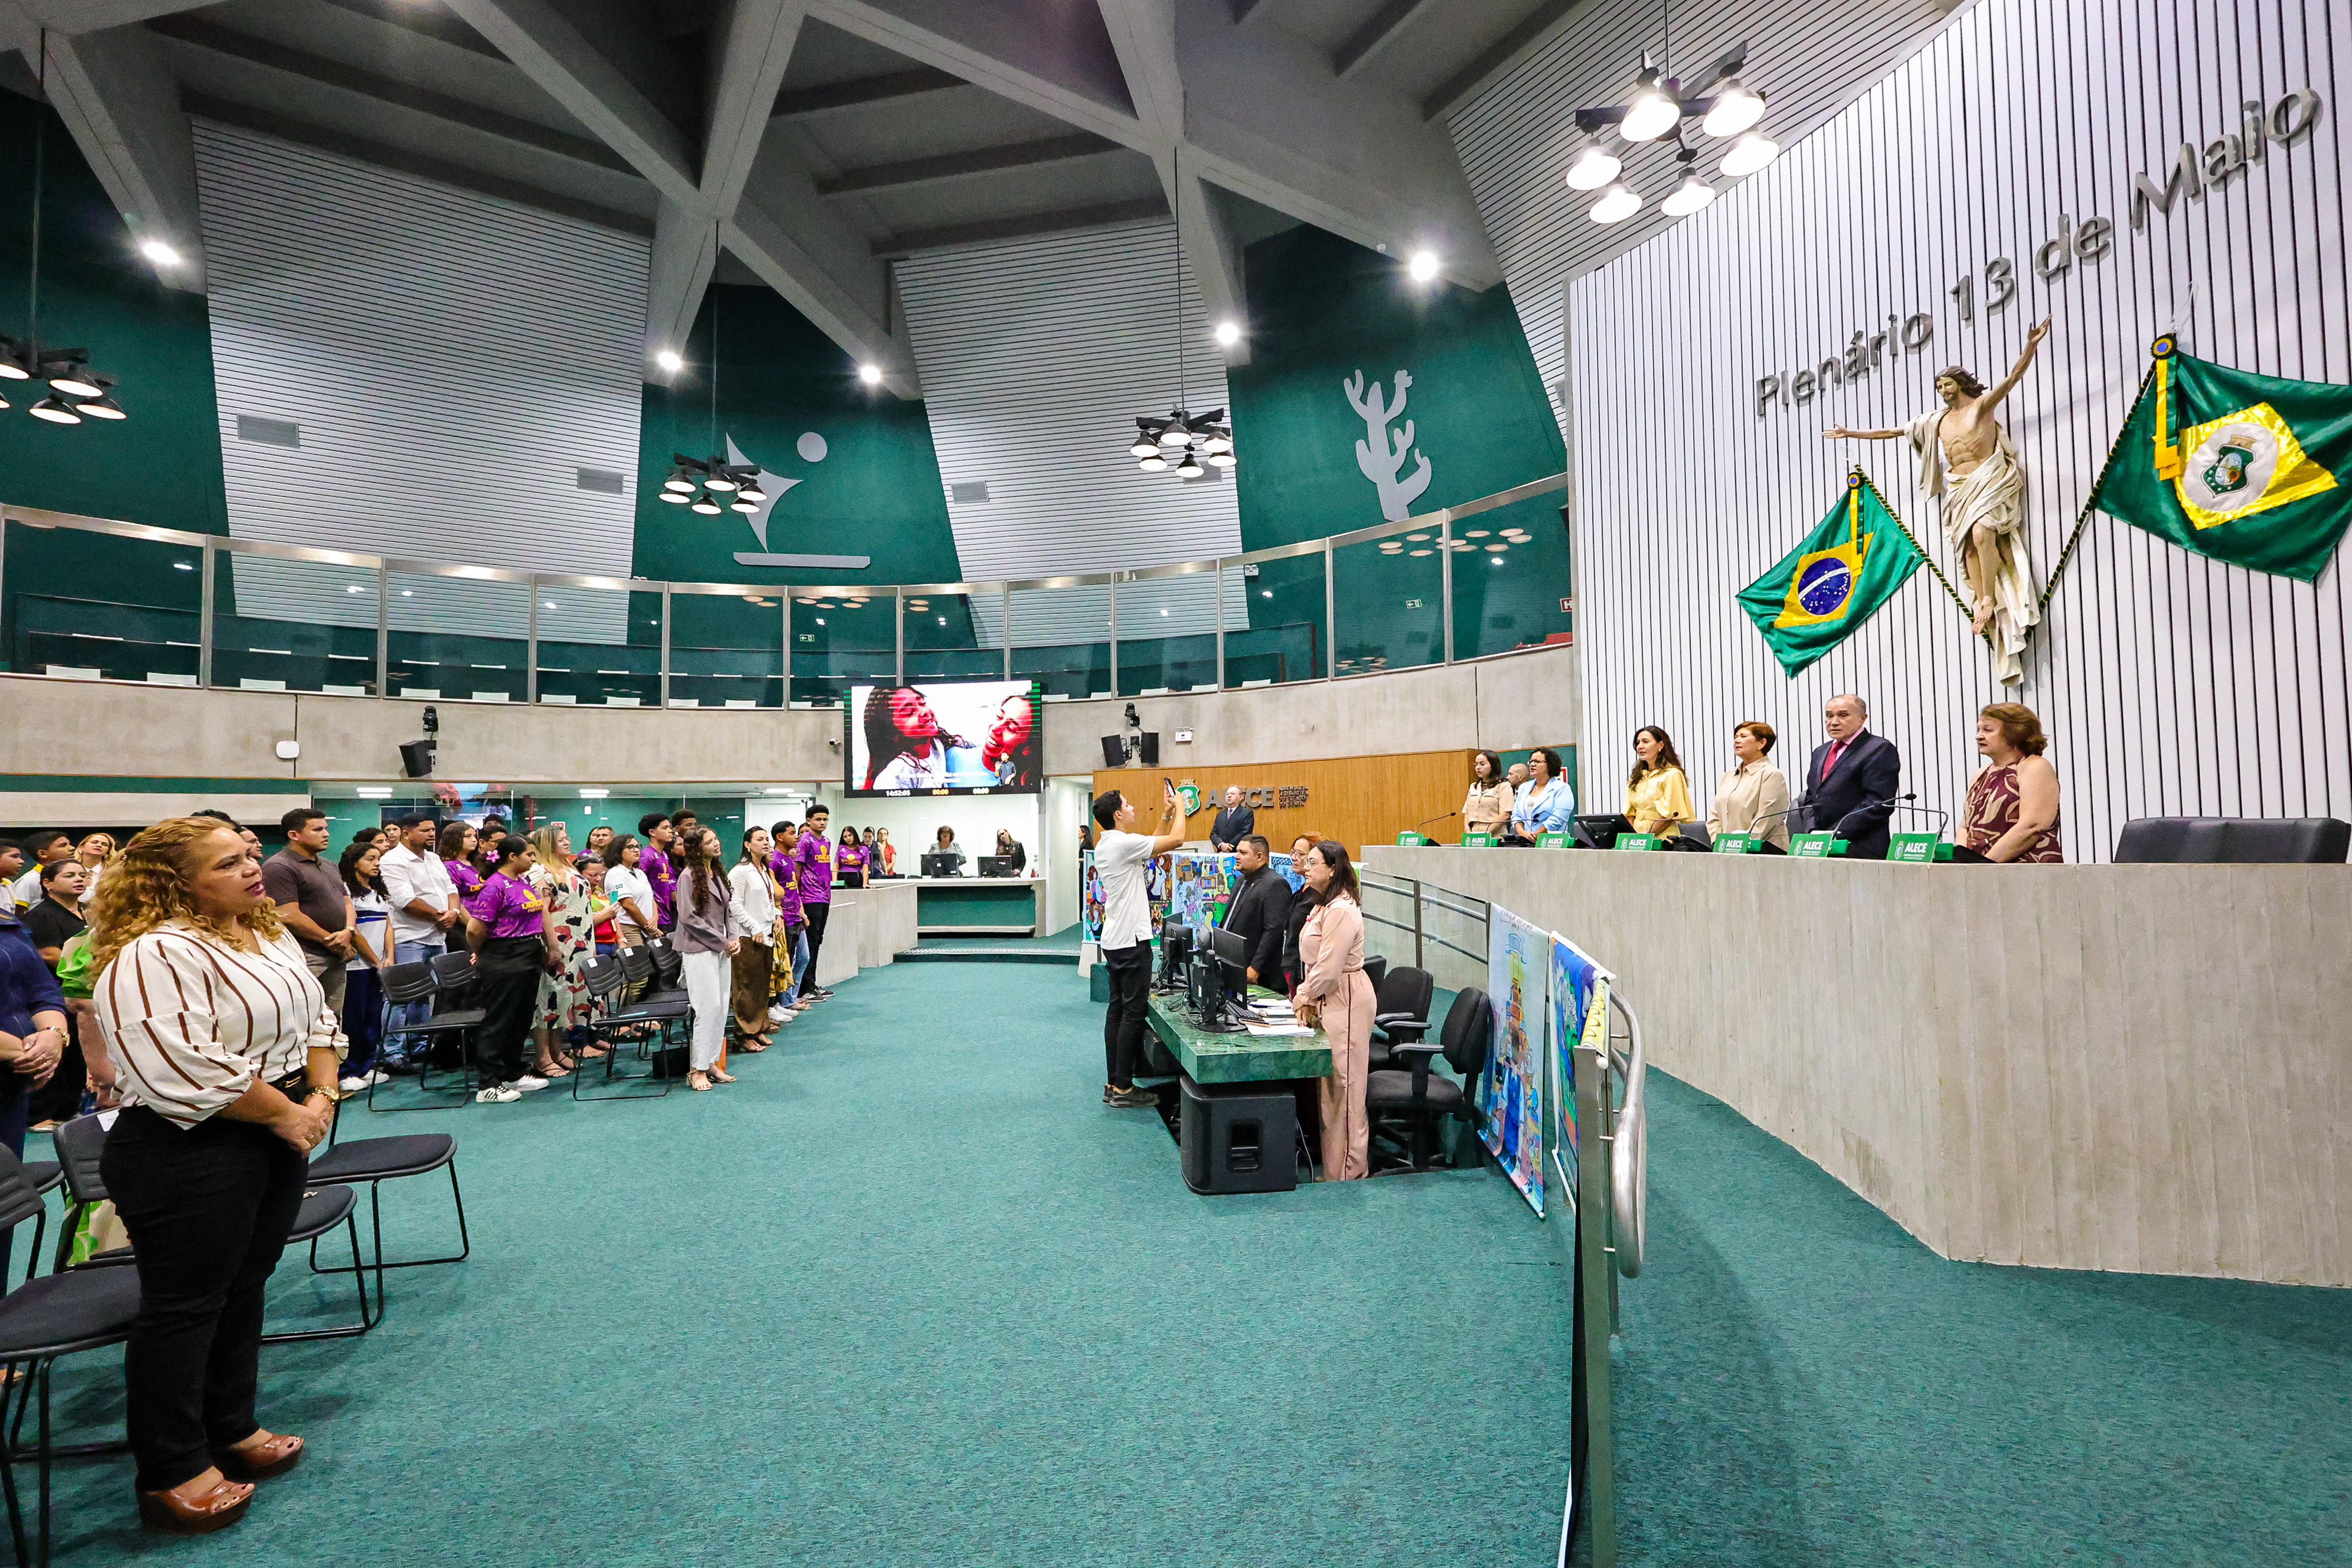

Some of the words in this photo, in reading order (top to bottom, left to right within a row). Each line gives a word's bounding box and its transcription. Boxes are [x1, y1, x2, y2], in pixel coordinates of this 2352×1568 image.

[1756, 312, 1934, 416] Plenário
[1949, 256, 2015, 321] 13
[2035, 213, 2111, 278] de
[2130, 88, 2324, 230] Maio
[1725, 840, 1743, 848] ALECE
[1802, 842, 1824, 850] ALECE
[1904, 843, 1928, 853] ALECE
